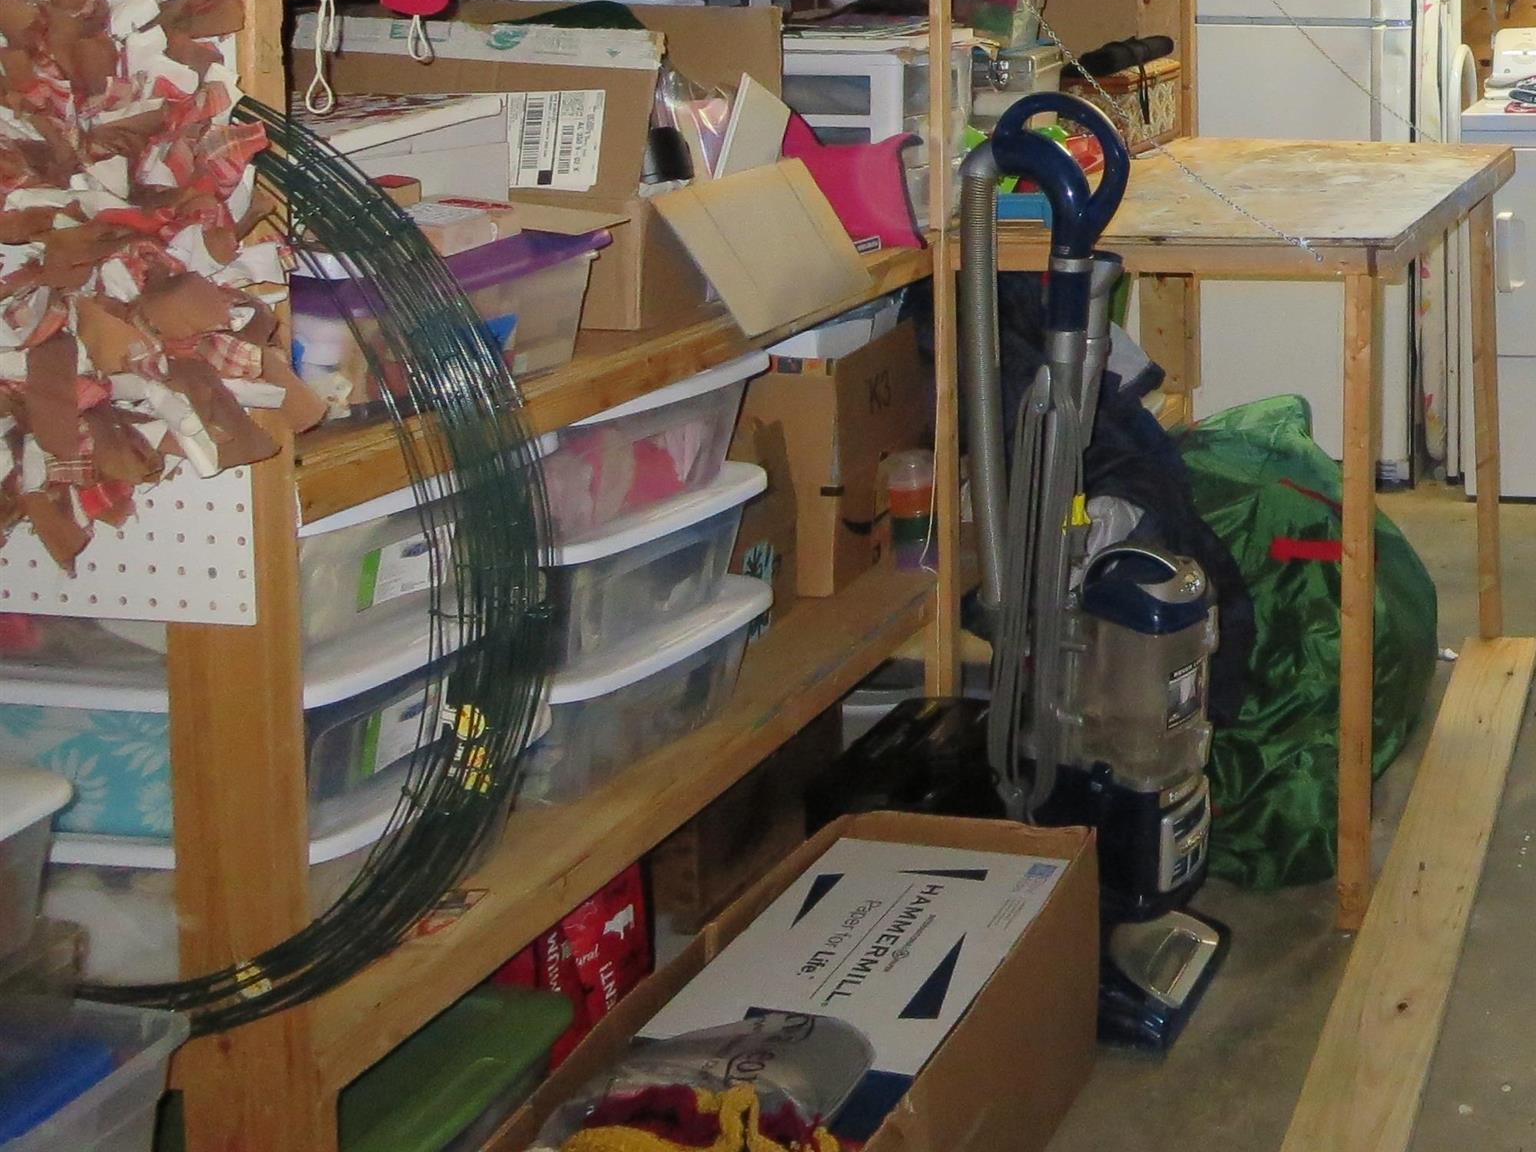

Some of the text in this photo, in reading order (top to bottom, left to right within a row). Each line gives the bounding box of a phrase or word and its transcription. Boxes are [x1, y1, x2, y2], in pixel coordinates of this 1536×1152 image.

[842, 899, 882, 930] Paper
[824, 932, 853, 948] for
[825, 883, 944, 1002] HAMMERMILL
